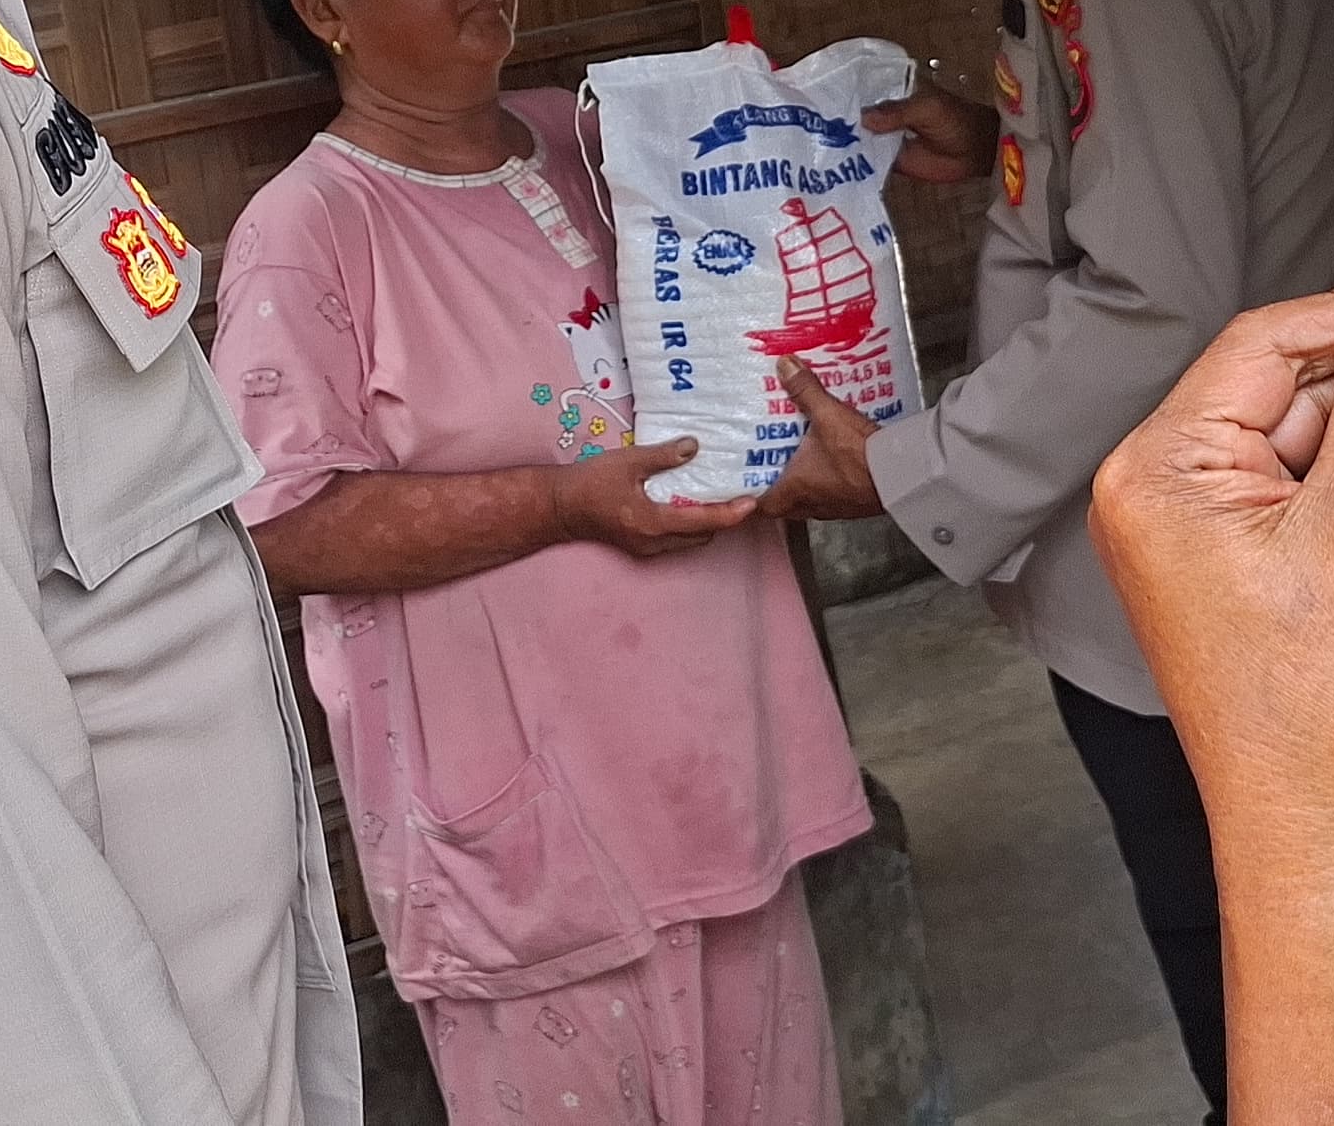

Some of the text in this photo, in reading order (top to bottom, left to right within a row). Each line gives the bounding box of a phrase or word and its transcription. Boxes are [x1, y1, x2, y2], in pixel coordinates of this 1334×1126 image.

[681, 158, 803, 196] BINTANG
[661, 321, 687, 350] IR
[668, 358, 693, 391] 64
